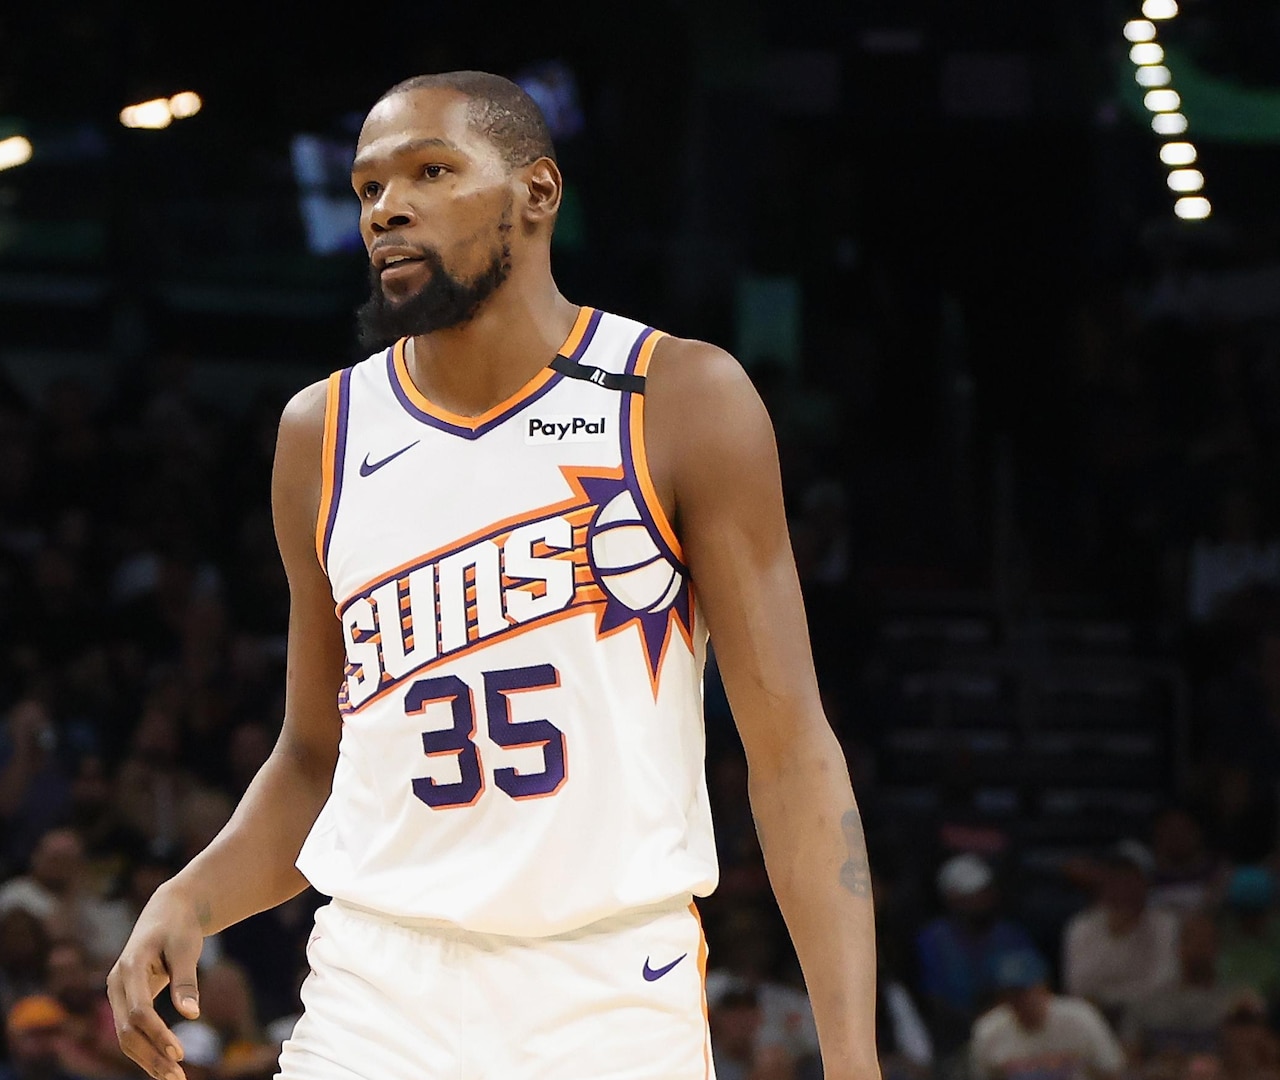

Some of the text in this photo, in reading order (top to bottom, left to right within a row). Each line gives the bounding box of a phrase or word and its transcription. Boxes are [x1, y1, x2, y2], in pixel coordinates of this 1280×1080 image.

[590, 368, 606, 385] AL
[529, 417, 605, 440] PayPal
[342, 516, 573, 708] SUNS
[404, 663, 568, 811] 35
